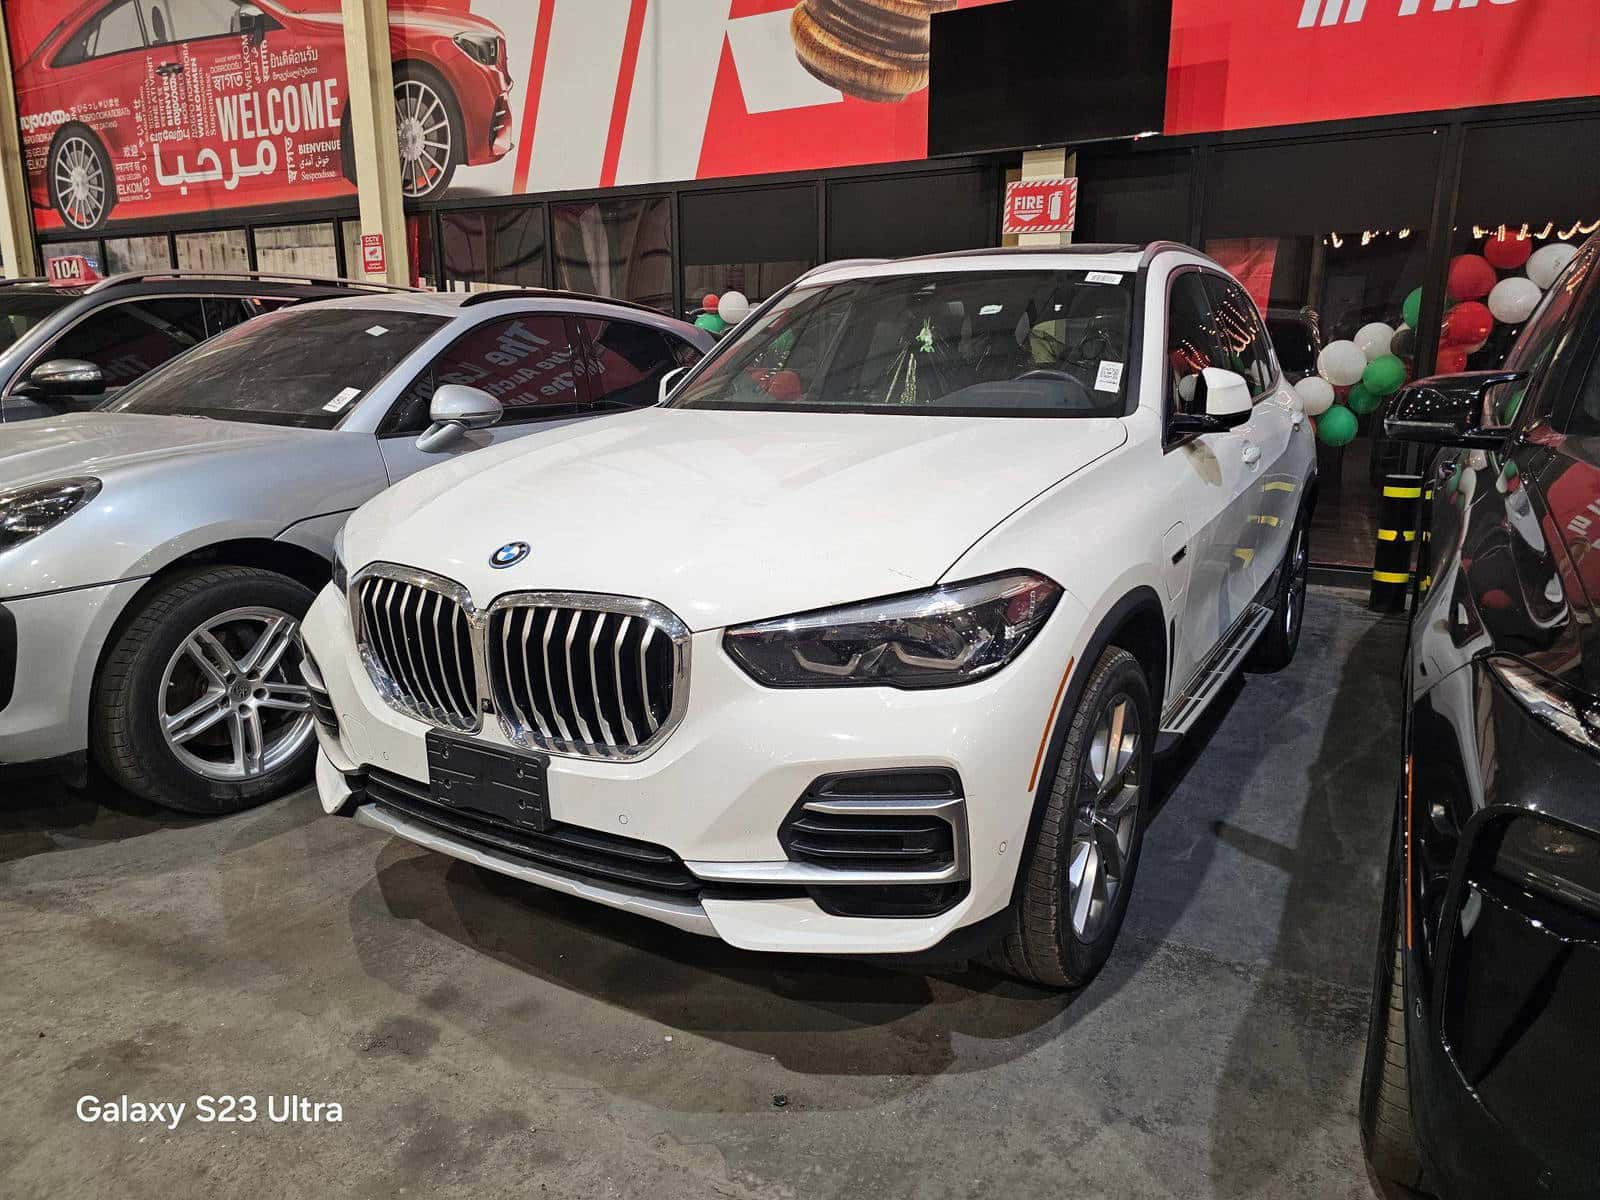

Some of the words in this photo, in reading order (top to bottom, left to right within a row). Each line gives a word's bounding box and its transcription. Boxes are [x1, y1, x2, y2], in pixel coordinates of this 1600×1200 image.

[242, 34, 253, 91] WELKOM
[190, 58, 204, 138] WILLKOMMEN
[215, 78, 341, 142] WELCOME
[152, 139, 279, 195] مرحبا
[297, 140, 342, 155] BIENVENUE
[1014, 195, 1044, 210] FIRE
[53, 260, 80, 279] 104
